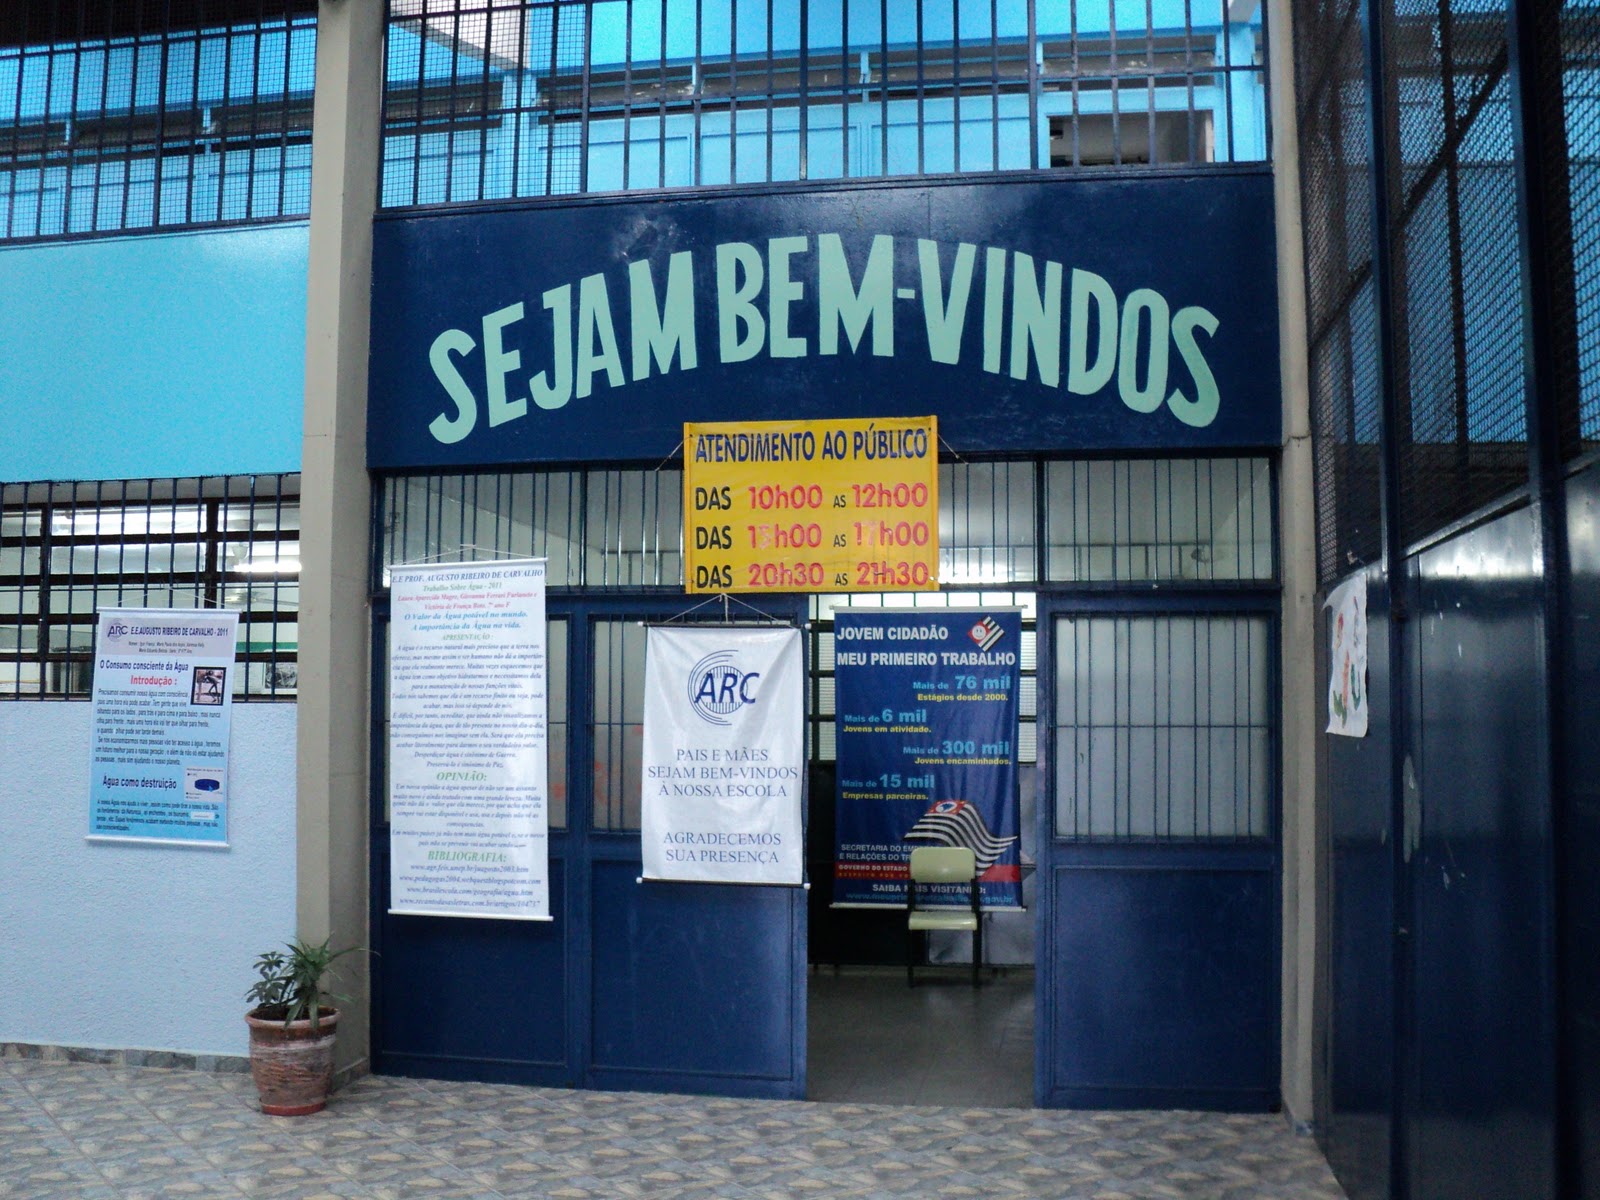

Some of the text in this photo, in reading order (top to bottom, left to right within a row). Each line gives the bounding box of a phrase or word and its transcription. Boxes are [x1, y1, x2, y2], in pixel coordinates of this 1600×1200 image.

[428, 233, 1222, 445] SEJAM BEM-VINDOS
[695, 423, 927, 463] ATENDIMENTO AO PÚBLICO
[695, 482, 929, 510] DAS 10h00 AS 12h00
[695, 525, 732, 550] DAS
[833, 534, 846, 548] AS
[427, 573, 460, 582] AUGUSTO
[461, 572, 490, 580] RIBEIRO
[503, 569, 543, 578] CARVALHO
[696, 561, 929, 589] DAS 20h30 AS 21h30
[107, 625, 128, 638] ARC
[162, 627, 181, 636] RIBEIRO
[182, 627, 189, 636] DE
[189, 627, 214, 637] CARVALHO
[217, 627, 229, 637] 2011
[837, 624, 948, 640] JOVEM CIDADÃO
[100, 658, 189, 673] O Consumo consciente da Água
[837, 652, 1016, 666] MEU PRIMEIRO TRABALHO
[130, 674, 173, 687] Introdução
[913, 675, 1011, 690] Mais de 76 mil
[694, 672, 760, 705] ARC
[917, 693, 1008, 702] Estágios desde 2000.
[844, 708, 927, 723] Mais de 6 mil
[843, 725, 873, 733] Jovens
[890, 725, 932, 733] atividade.
[676, 746, 768, 761] PAIS E MÃES
[903, 740, 1009, 755] Mais de 300 mil
[914, 757, 1012, 765] Jovens encaminhados.
[436, 770, 487, 781] OPINIÃO:
[648, 766, 798, 780] SEJAM BEM-VINDOS
[102, 772, 177, 791] Água como destruição
[842, 774, 935, 788] Mais de 15 mil
[658, 780, 787, 797] À NOSSA ESCOLA
[842, 792, 929, 801] Empresas parceiras.
[663, 832, 781, 846] AGRADECEMOS
[841, 844, 888, 852] SECRETARIA
[428, 851, 506, 862] BIBLIOGRAFIA:
[666, 849, 779, 864] SUA PRESENÇA
[846, 852, 887, 861] RELAÇÕES
[872, 884, 902, 892] SAIBA
